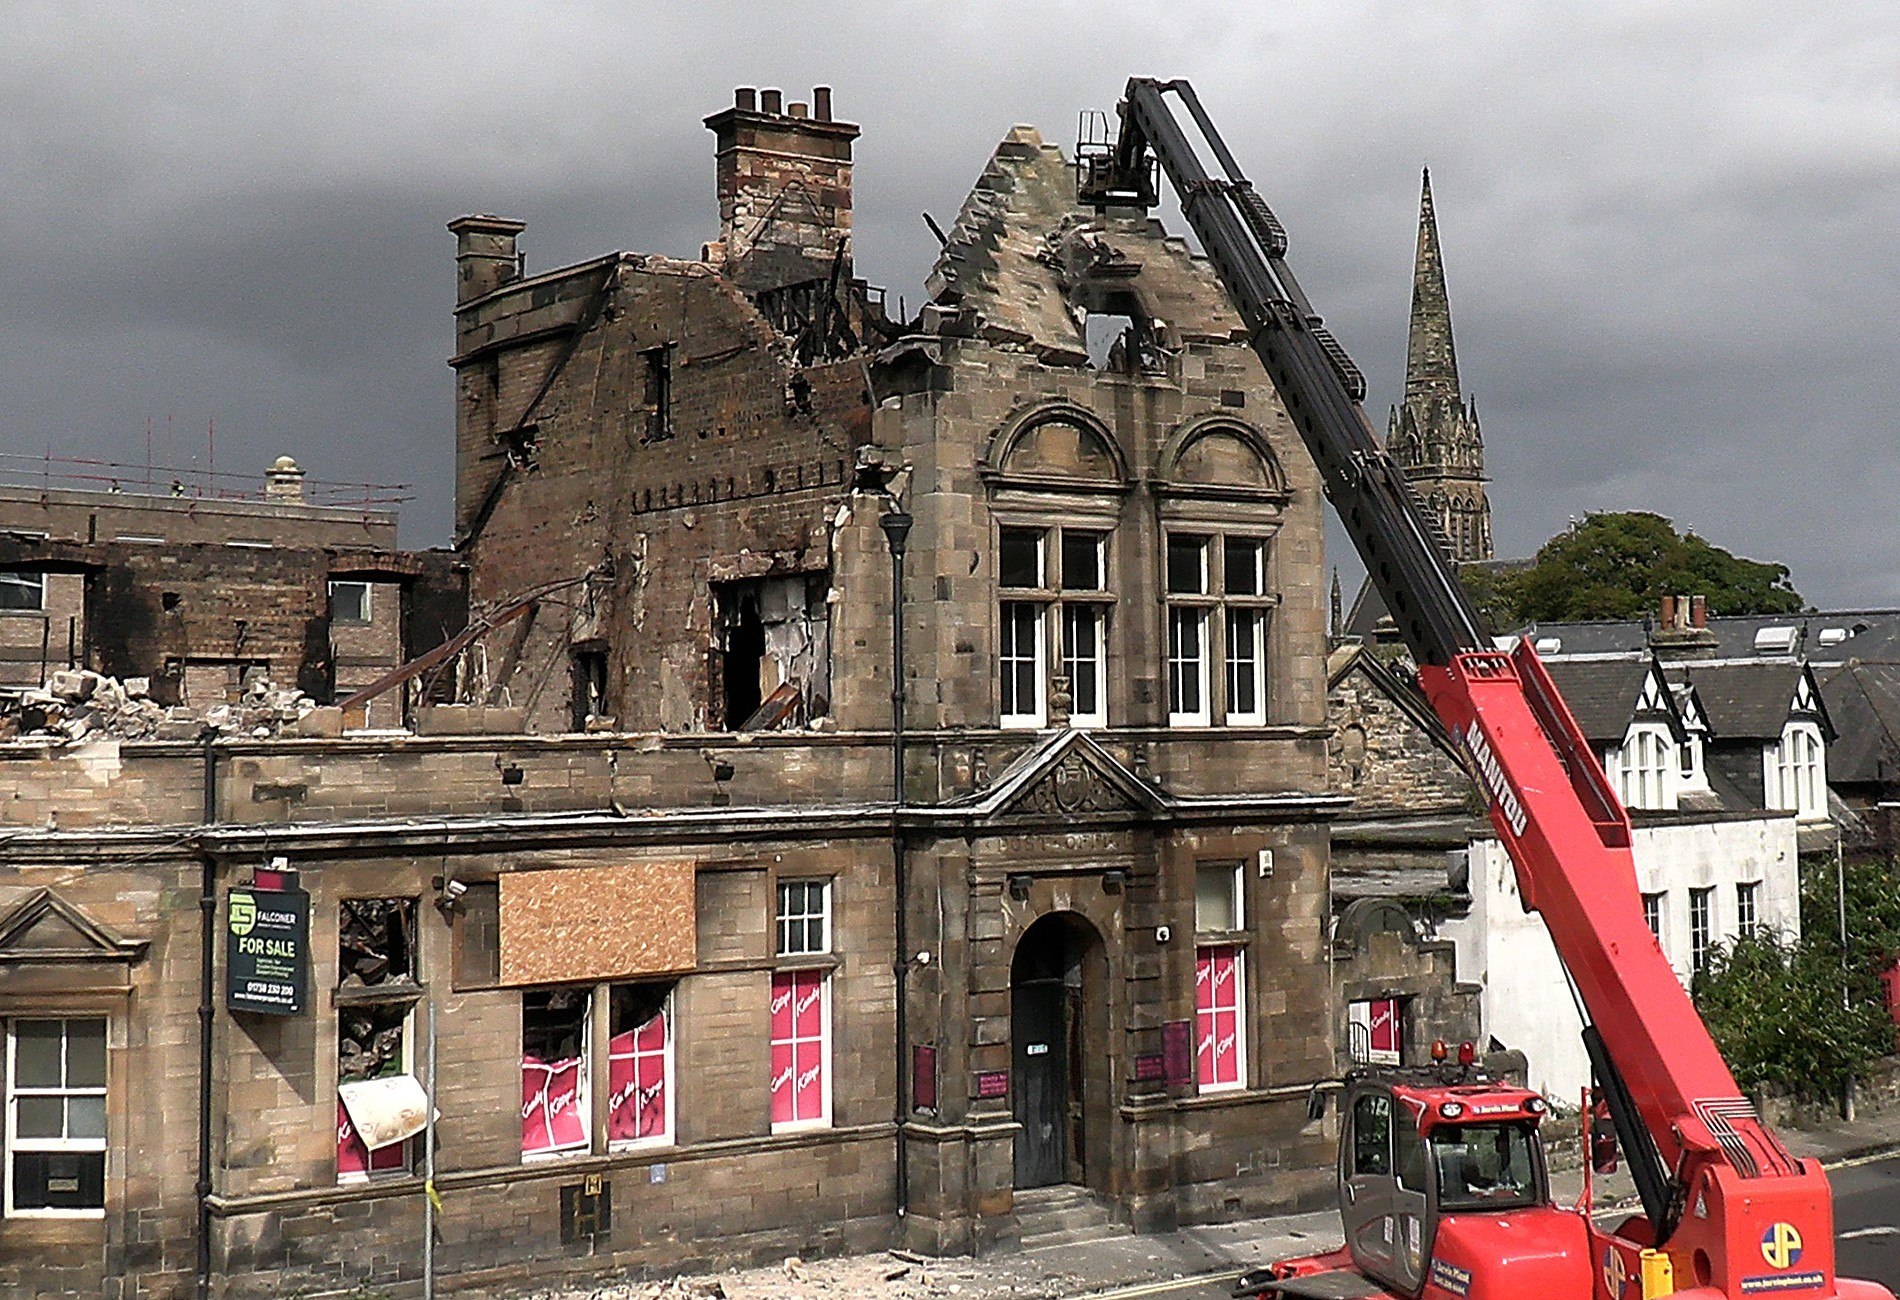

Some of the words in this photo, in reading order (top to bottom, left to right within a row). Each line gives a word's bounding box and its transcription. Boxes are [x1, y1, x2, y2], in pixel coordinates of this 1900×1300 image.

[998, 836, 1046, 852] POST
[257, 911, 296, 924] FALCONER
[238, 937, 264, 955] FOR
[265, 938, 295, 958] SALE
